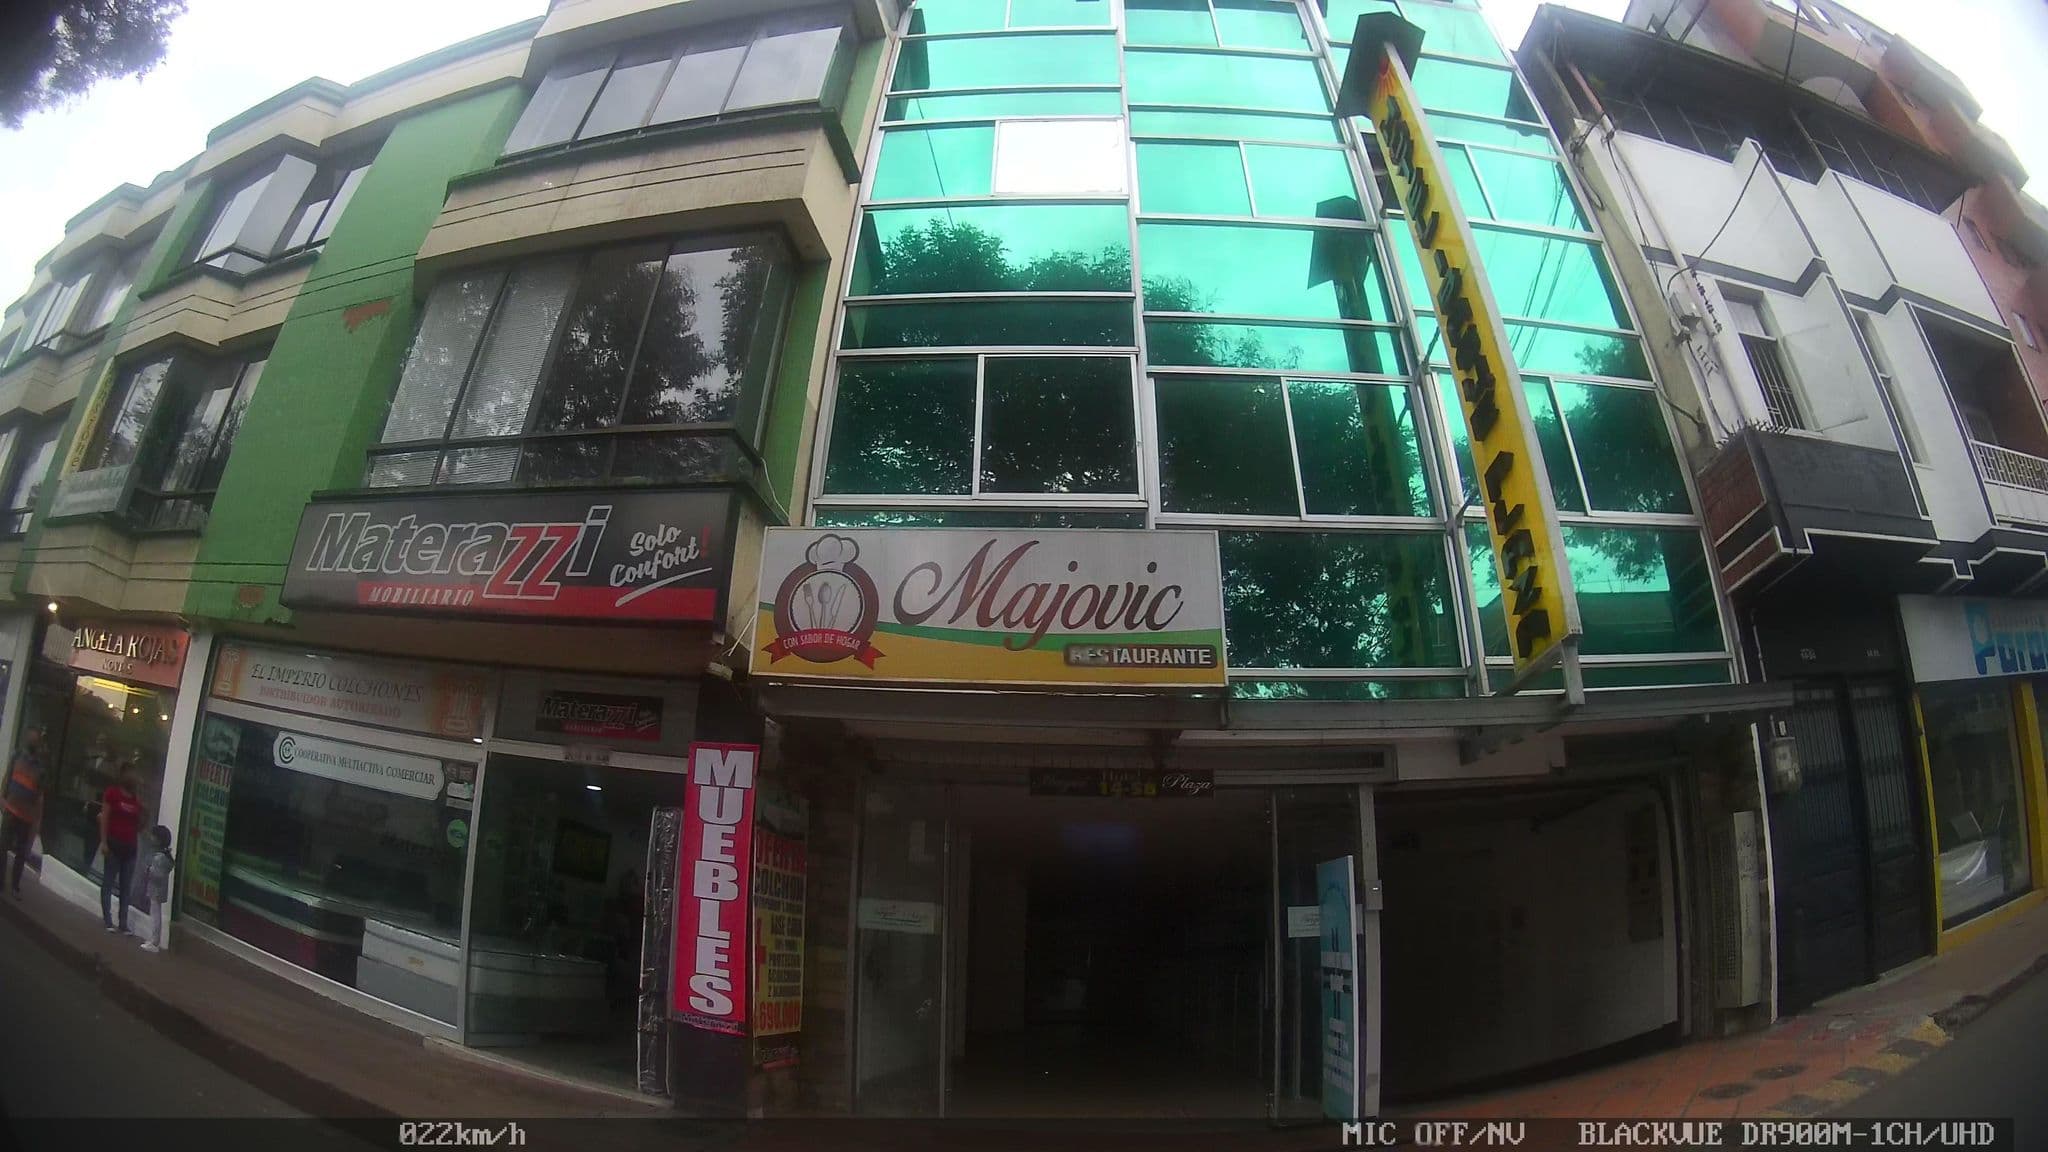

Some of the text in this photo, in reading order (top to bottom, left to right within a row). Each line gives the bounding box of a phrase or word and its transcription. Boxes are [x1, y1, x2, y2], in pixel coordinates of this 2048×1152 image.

[305, 504, 613, 601] Materazzi
[629, 522, 682, 558] Solo
[1484, 450, 1551, 659] PLAZA
[367, 584, 475, 607] MOBILIARIO
[893, 538, 1184, 651] Majovic
[71, 627, 124, 655] ANGELA
[783, 633, 861, 650] CON SABOR DE HOGAR
[251, 664, 425, 704] EL IMPERIO COLCHONES
[294, 747, 337, 766] COOPERATIVA
[338, 755, 384, 776] MULTIACTIVA
[385, 765, 437, 786] COMERCIAR
[1161, 774, 1213, 796] Plaza
[689, 747, 755, 1017] MUEBLES
